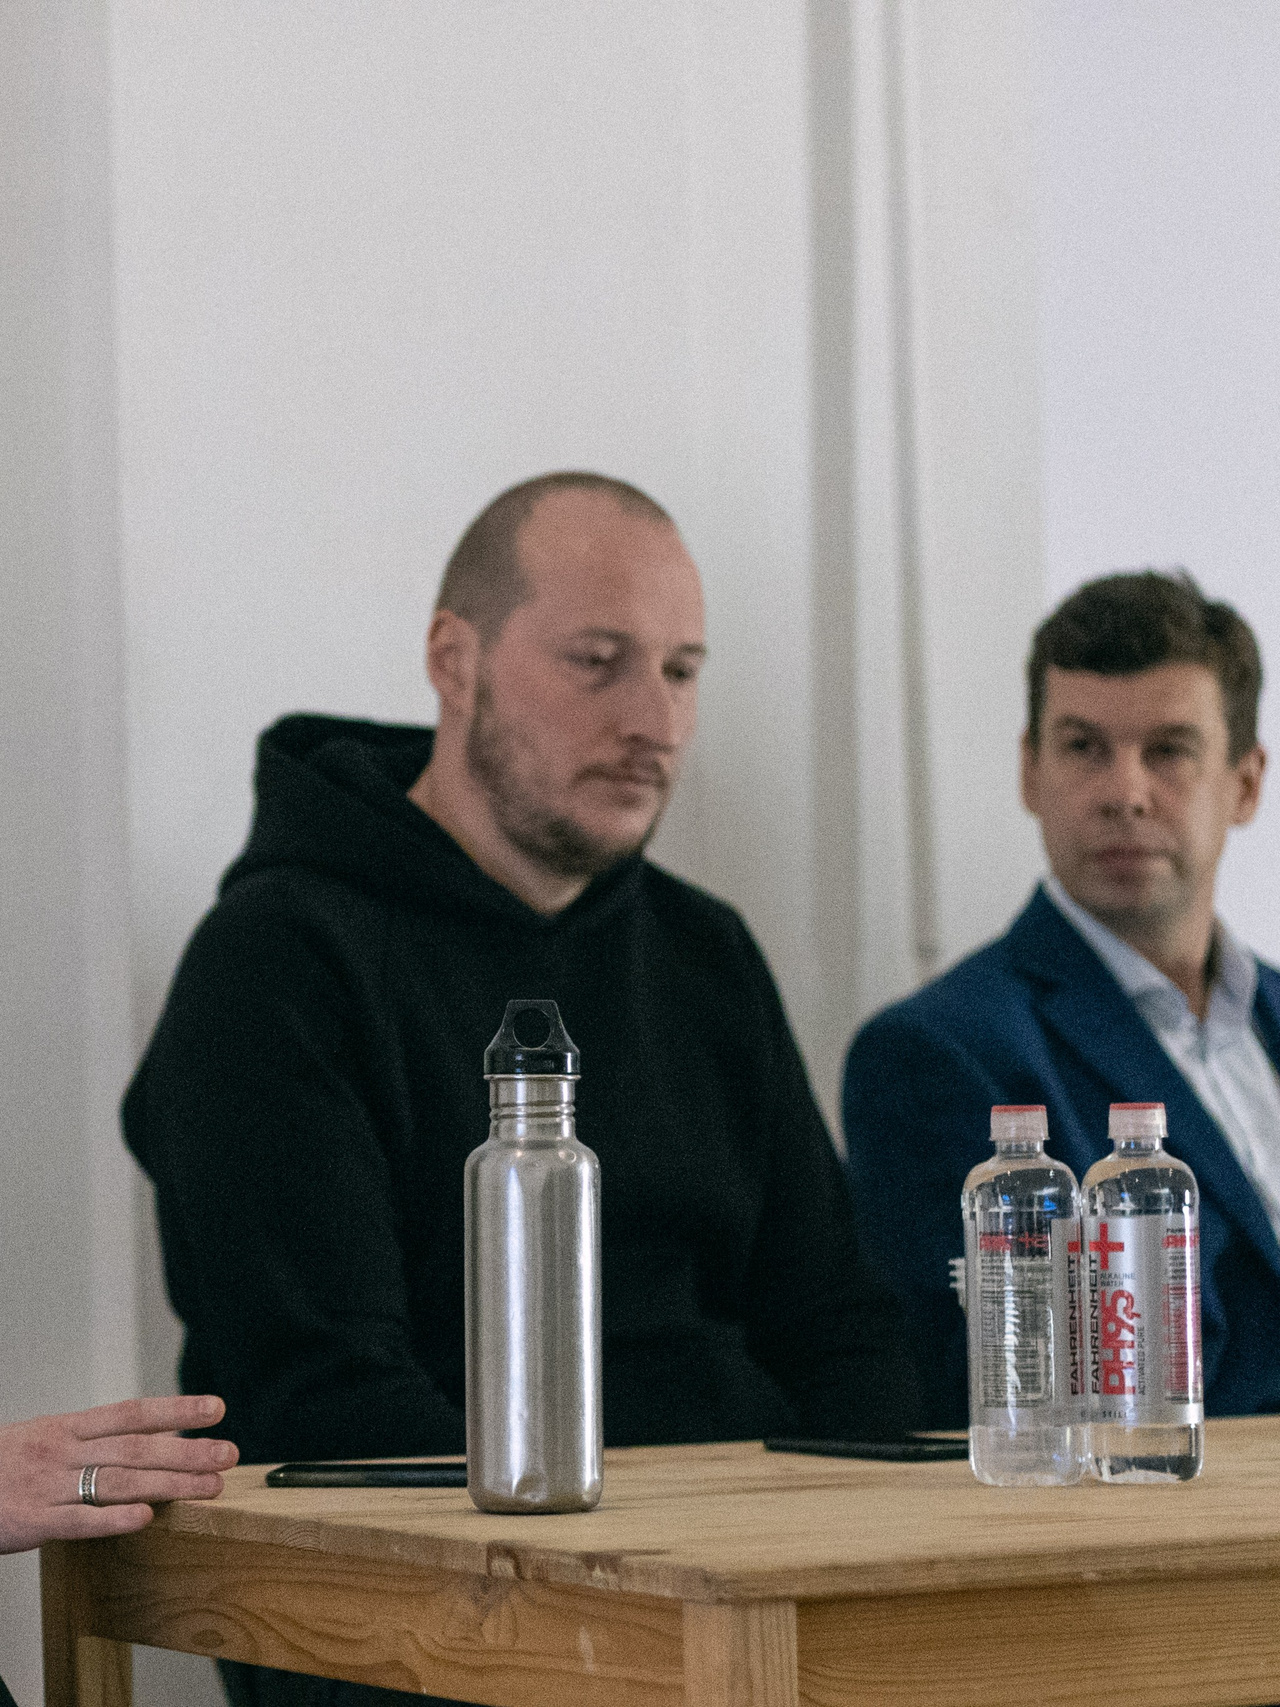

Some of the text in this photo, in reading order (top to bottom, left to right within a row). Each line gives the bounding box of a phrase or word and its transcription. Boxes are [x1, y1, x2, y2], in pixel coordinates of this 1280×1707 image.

[1067, 1255, 1079, 1396] FAHRENHEIT
[1089, 1254, 1100, 1395] FAHRENHEIT
[1136, 1326, 1146, 1396] ACTIVATED PURE
